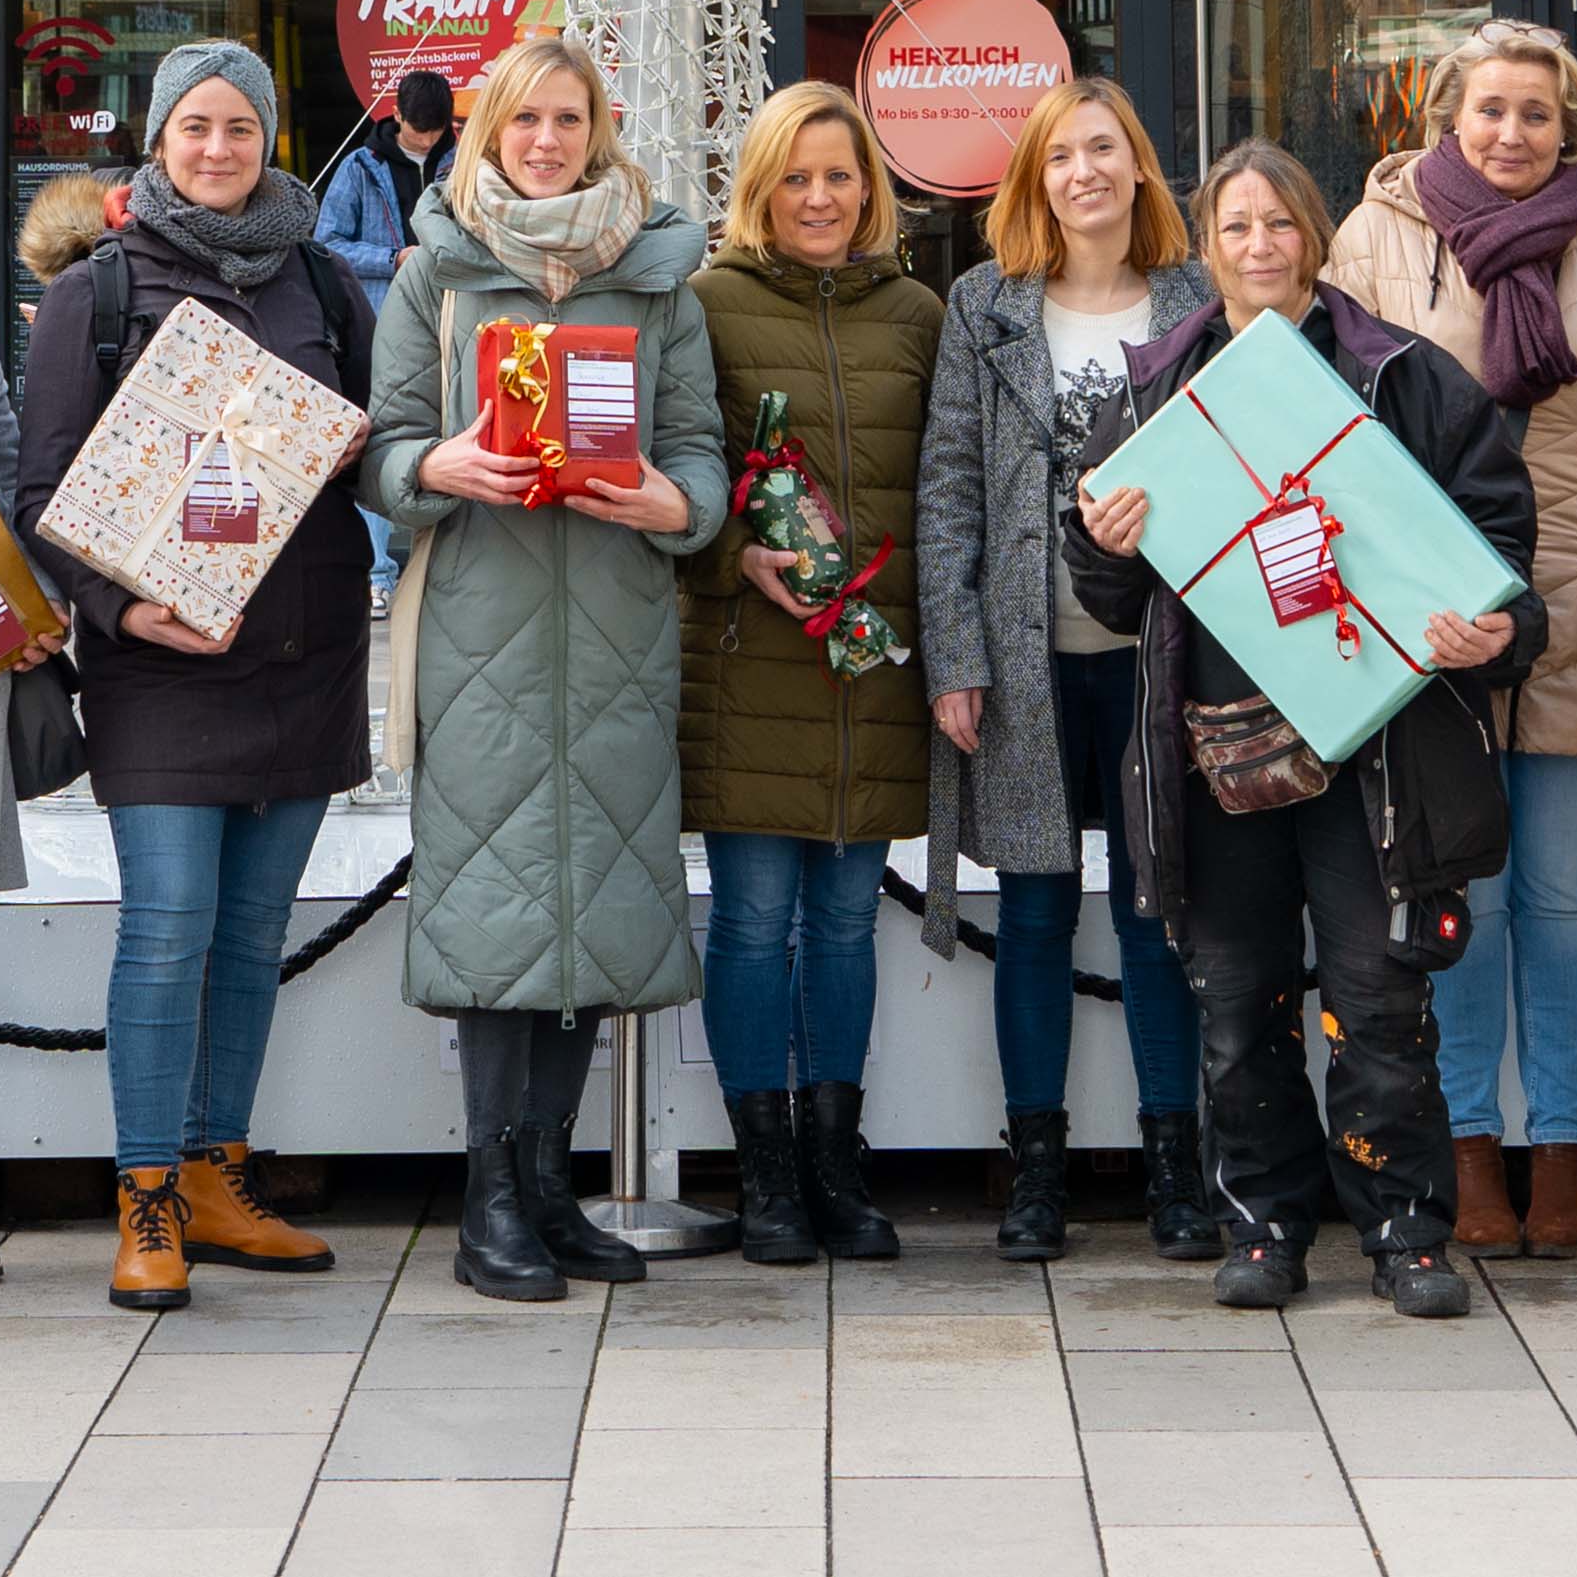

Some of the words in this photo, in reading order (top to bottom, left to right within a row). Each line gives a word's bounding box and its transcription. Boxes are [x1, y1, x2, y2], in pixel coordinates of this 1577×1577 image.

[386, 19, 408, 36] IN
[412, 18, 490, 36] HANAU
[889, 46, 1020, 67] HERZLICH
[371, 68, 386, 80] für
[876, 62, 1058, 89] WILLKOMMEN
[877, 108, 897, 119] Mo
[900, 108, 919, 119] bis
[921, 108, 938, 119] Sa
[17, 162, 90, 172] HAUSORDNUNG
